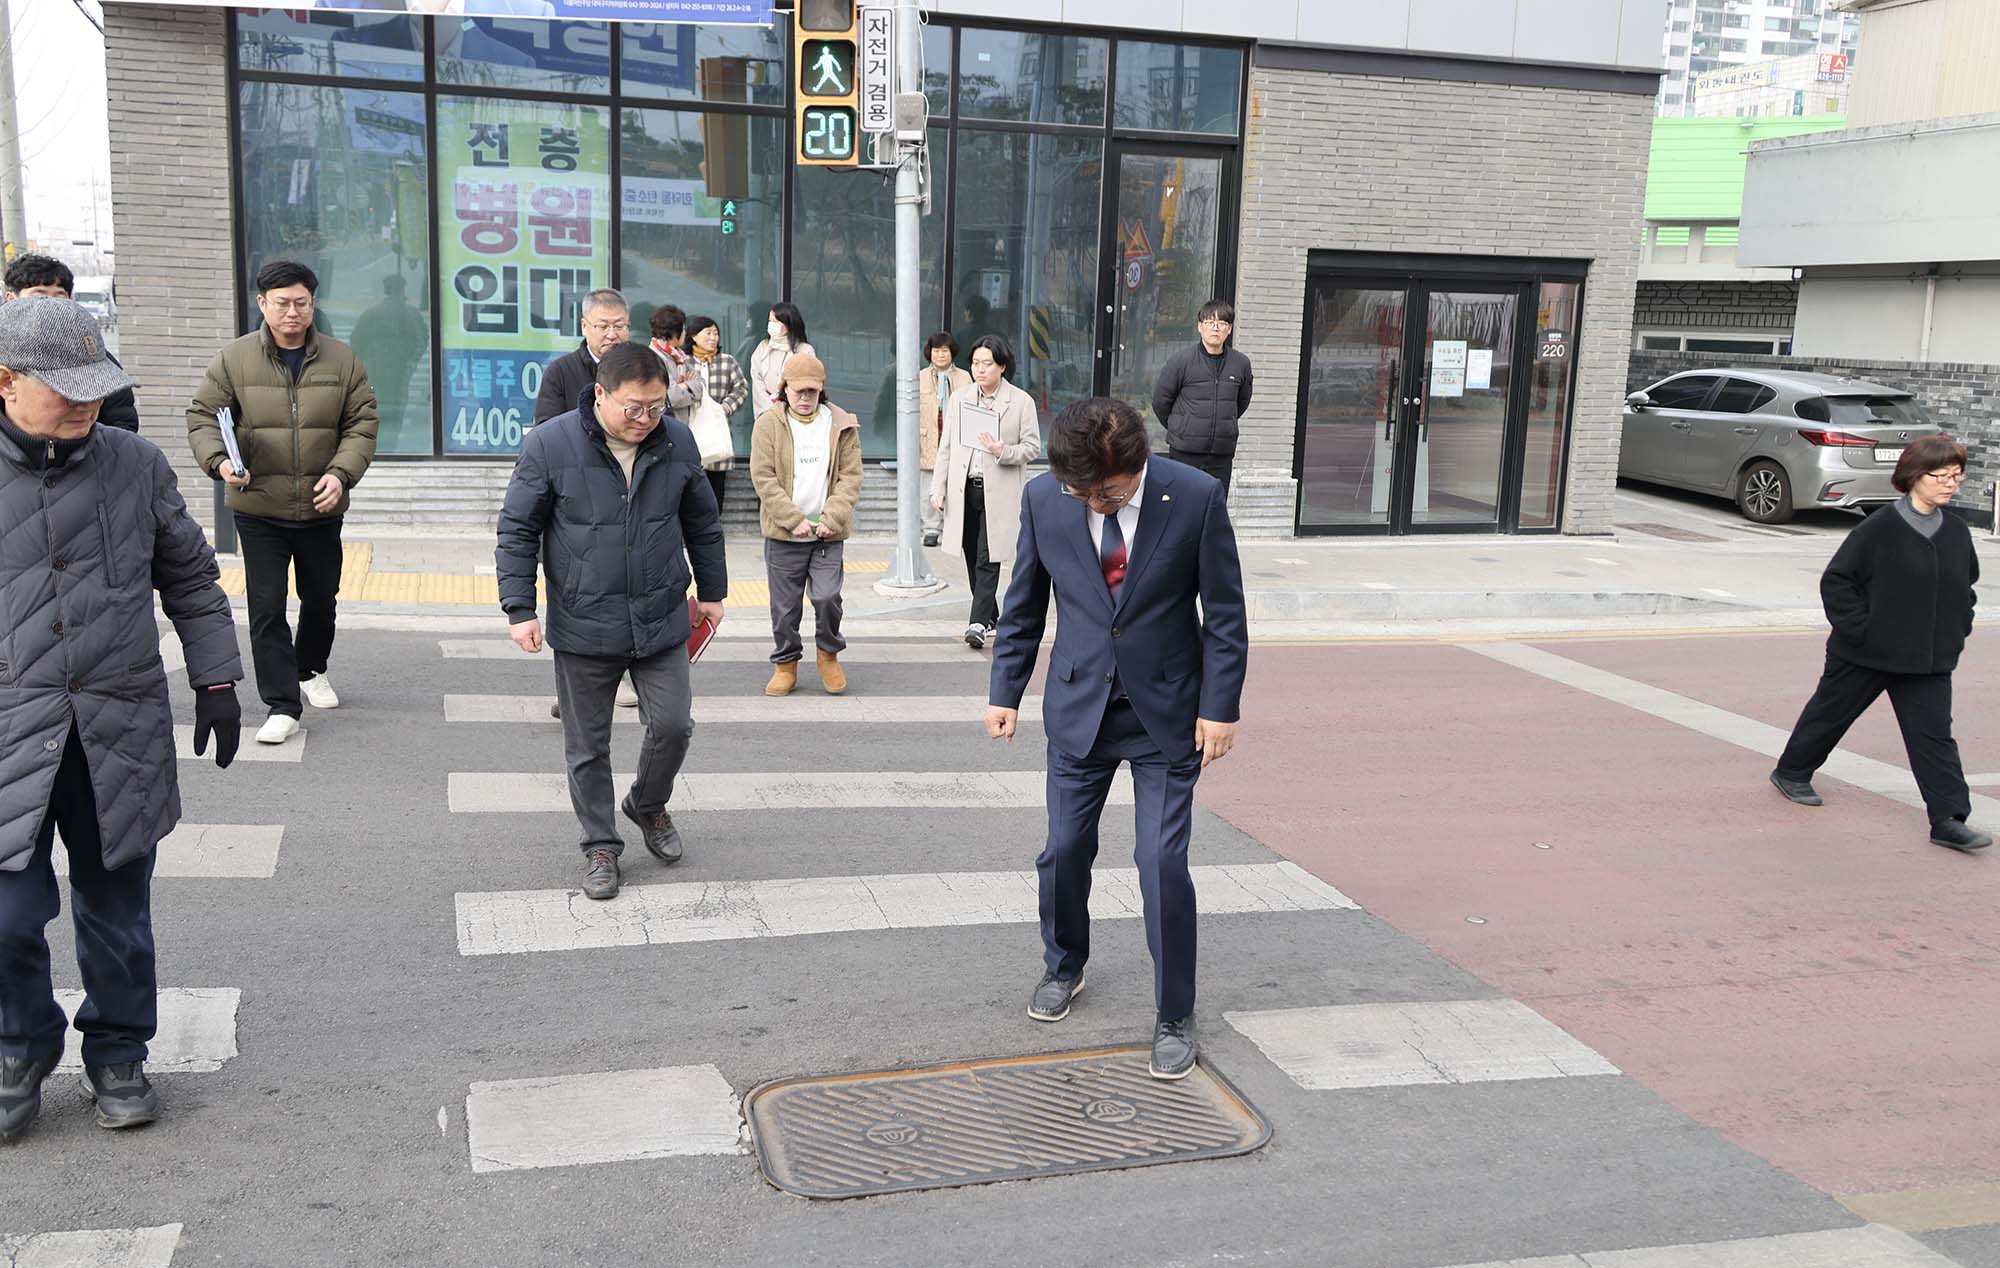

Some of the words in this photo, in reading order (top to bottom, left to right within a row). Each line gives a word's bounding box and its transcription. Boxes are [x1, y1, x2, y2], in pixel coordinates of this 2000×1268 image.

[868, 17, 888, 76] 자전거
[868, 83, 888, 122] 겸용
[806, 112, 849, 154] 20
[455, 182, 592, 257] 병원
[455, 265, 592, 337] 임대
[1542, 344, 1565, 357] 220
[449, 358, 516, 398] 건물주
[522, 361, 544, 400] 0
[451, 407, 535, 447] 4406-
